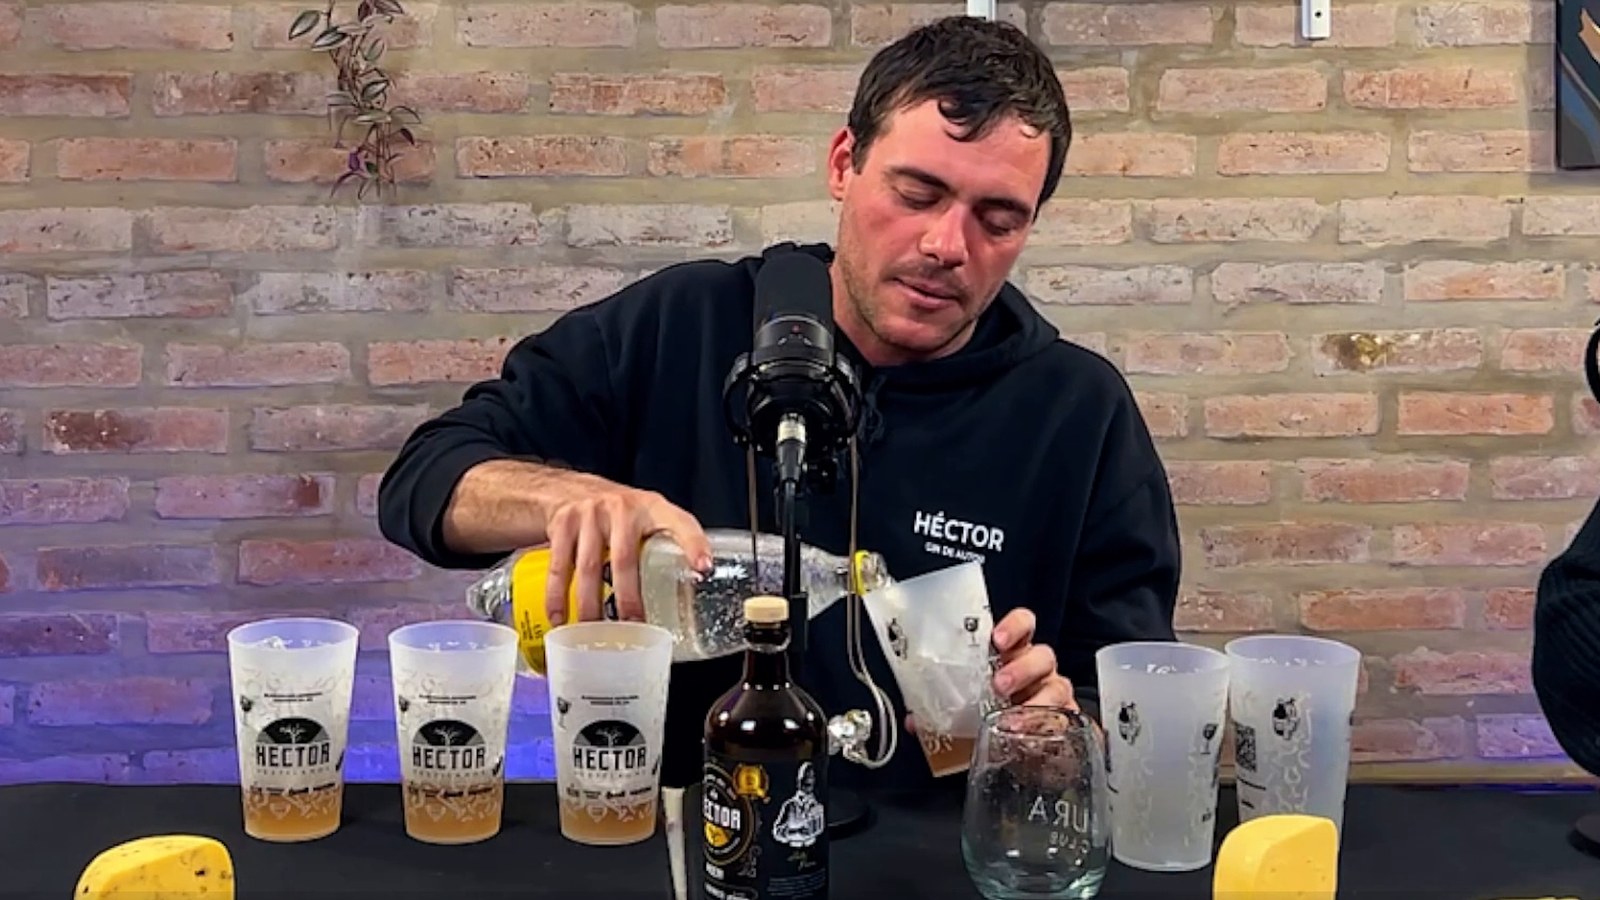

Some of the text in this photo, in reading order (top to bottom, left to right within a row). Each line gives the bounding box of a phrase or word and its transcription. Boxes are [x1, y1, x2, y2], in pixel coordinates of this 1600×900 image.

[913, 510, 1004, 552] HÉCTOR
[256, 742, 330, 767] HECTOR
[412, 746, 485, 769] HECTOR
[573, 746, 647, 771] HECTOR
